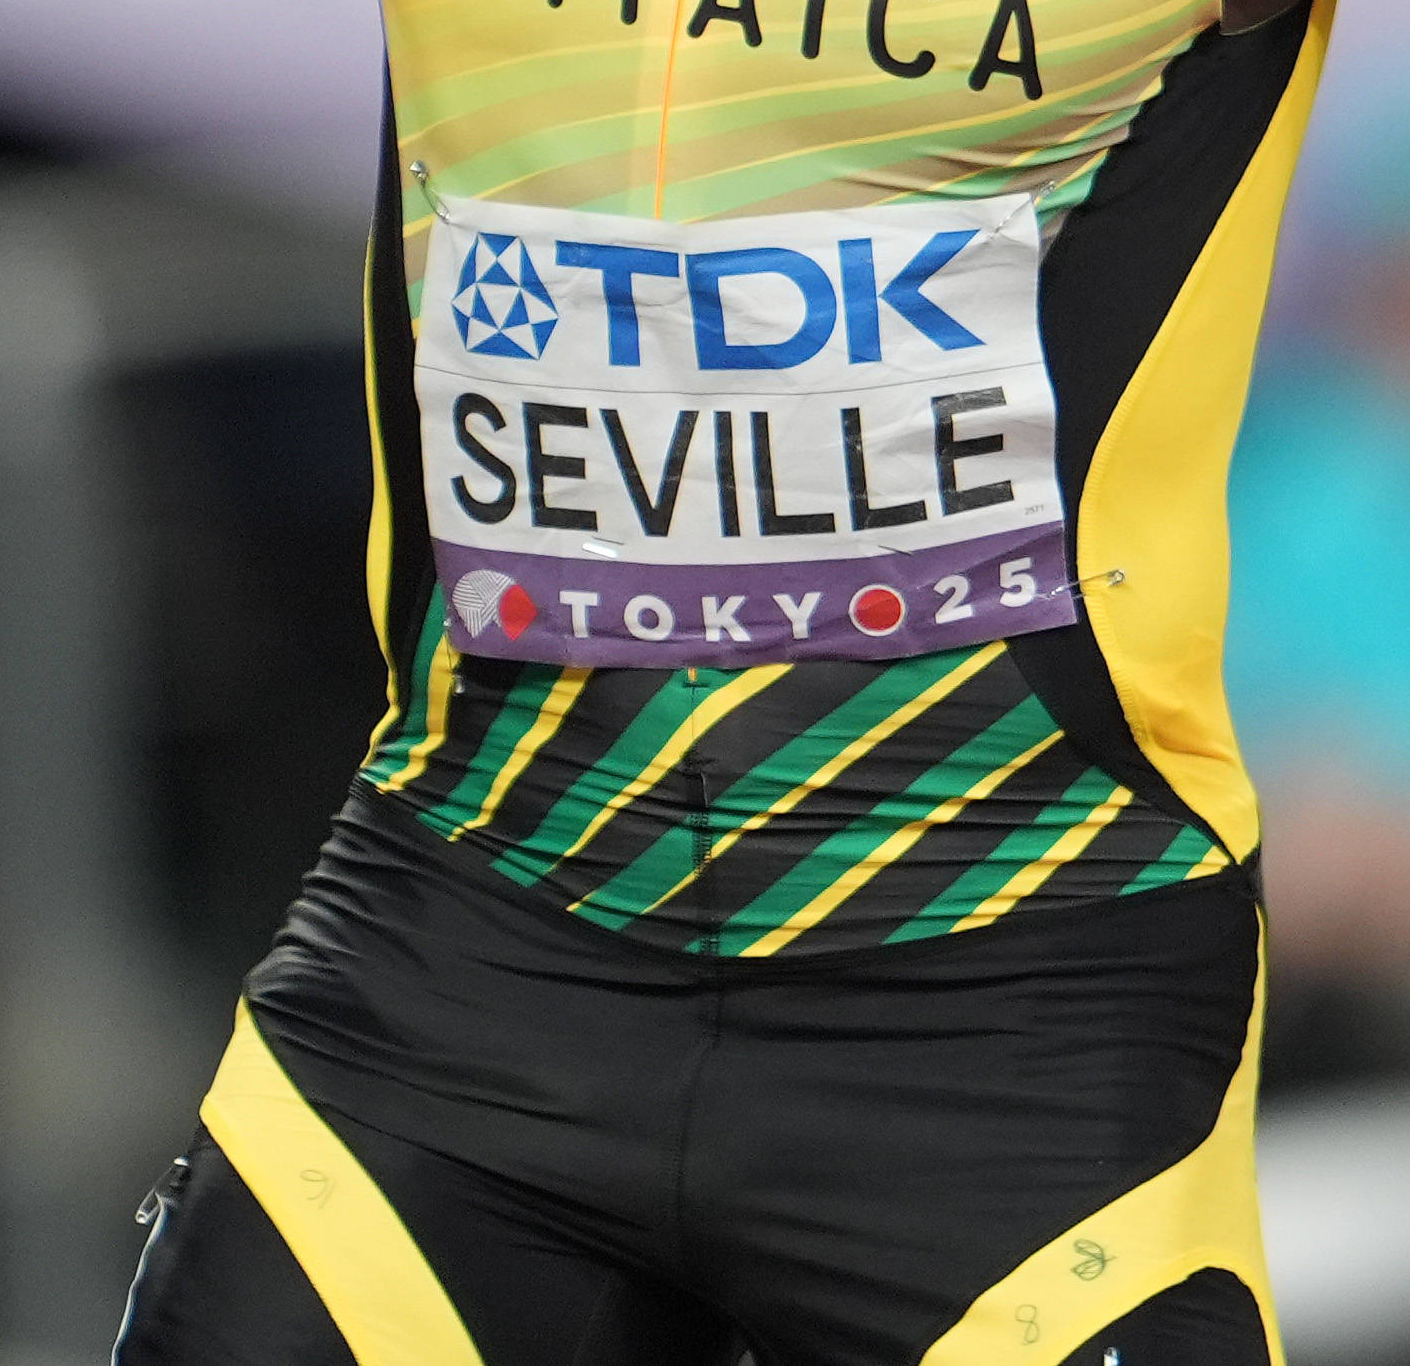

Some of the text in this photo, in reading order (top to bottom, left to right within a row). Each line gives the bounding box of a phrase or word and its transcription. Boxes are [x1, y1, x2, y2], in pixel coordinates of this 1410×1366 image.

[556, 229, 986, 370] TDK
[451, 386, 1015, 538] SEVILLE
[934, 558, 1038, 625] 25
